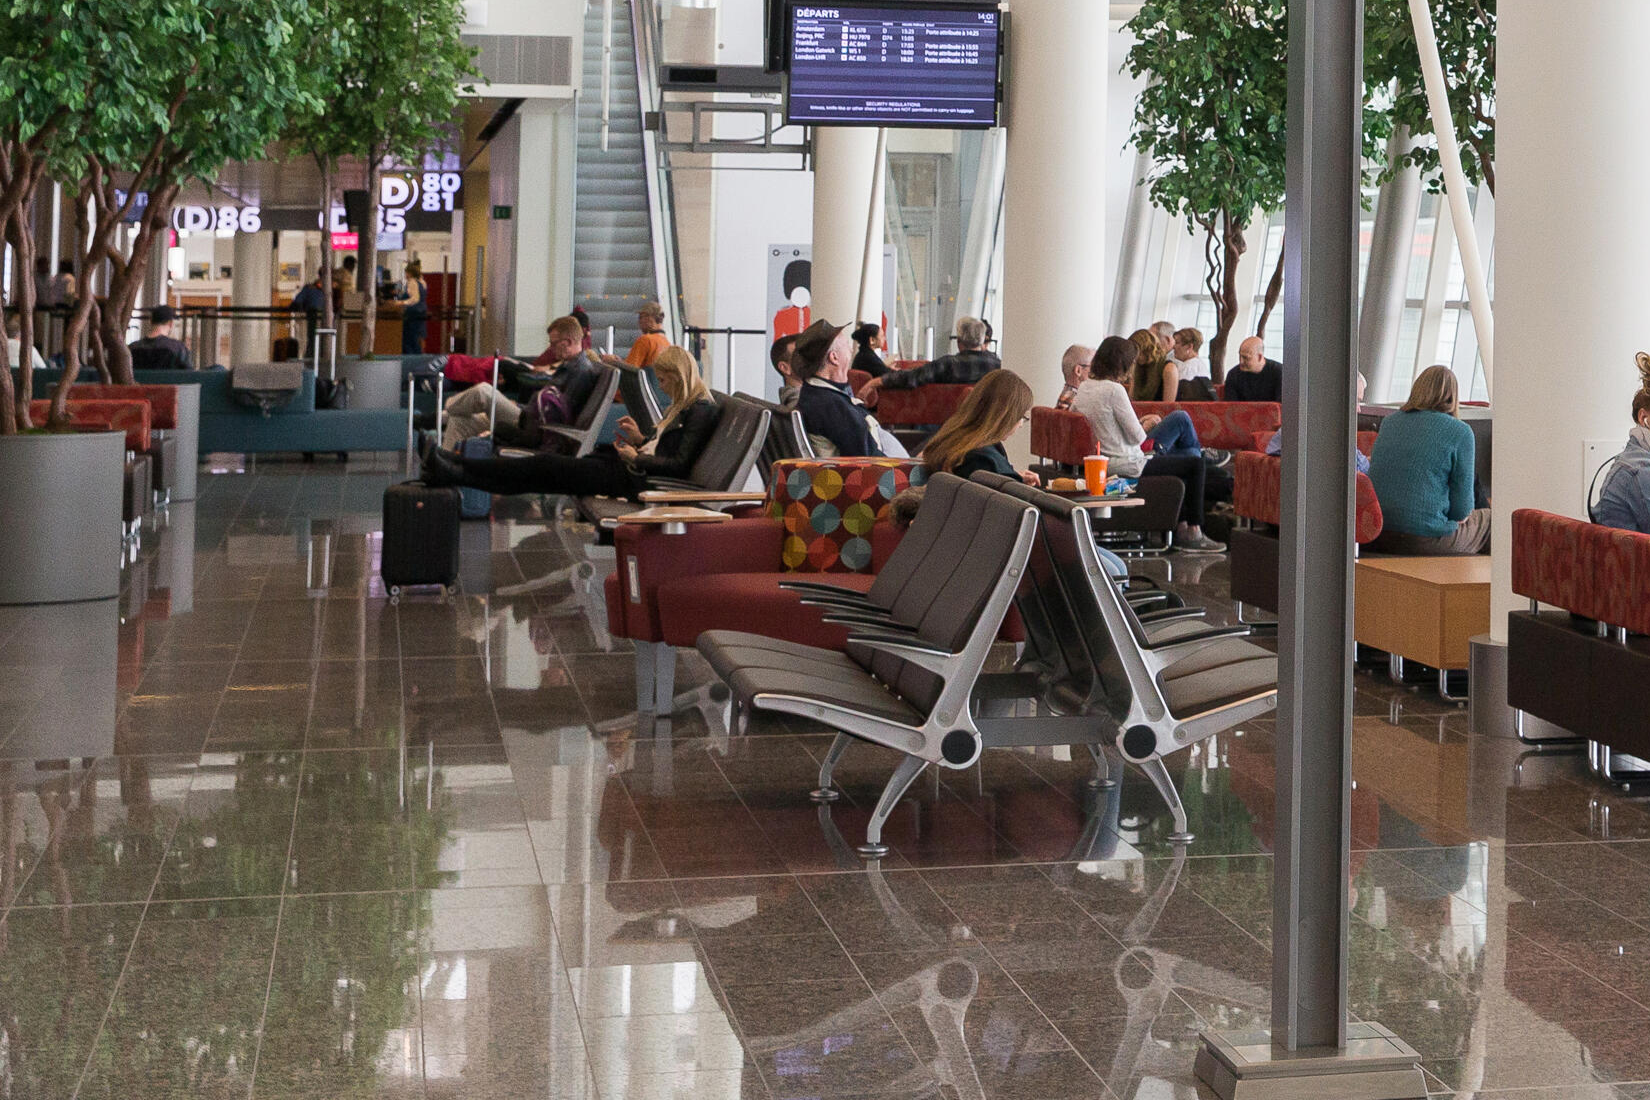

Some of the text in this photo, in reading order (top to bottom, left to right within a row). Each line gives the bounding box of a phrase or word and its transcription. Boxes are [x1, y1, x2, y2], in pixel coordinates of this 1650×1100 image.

[796, 7, 840, 19] DÉPARTS
[422, 173, 461, 192] 80
[422, 192, 454, 211] 81
